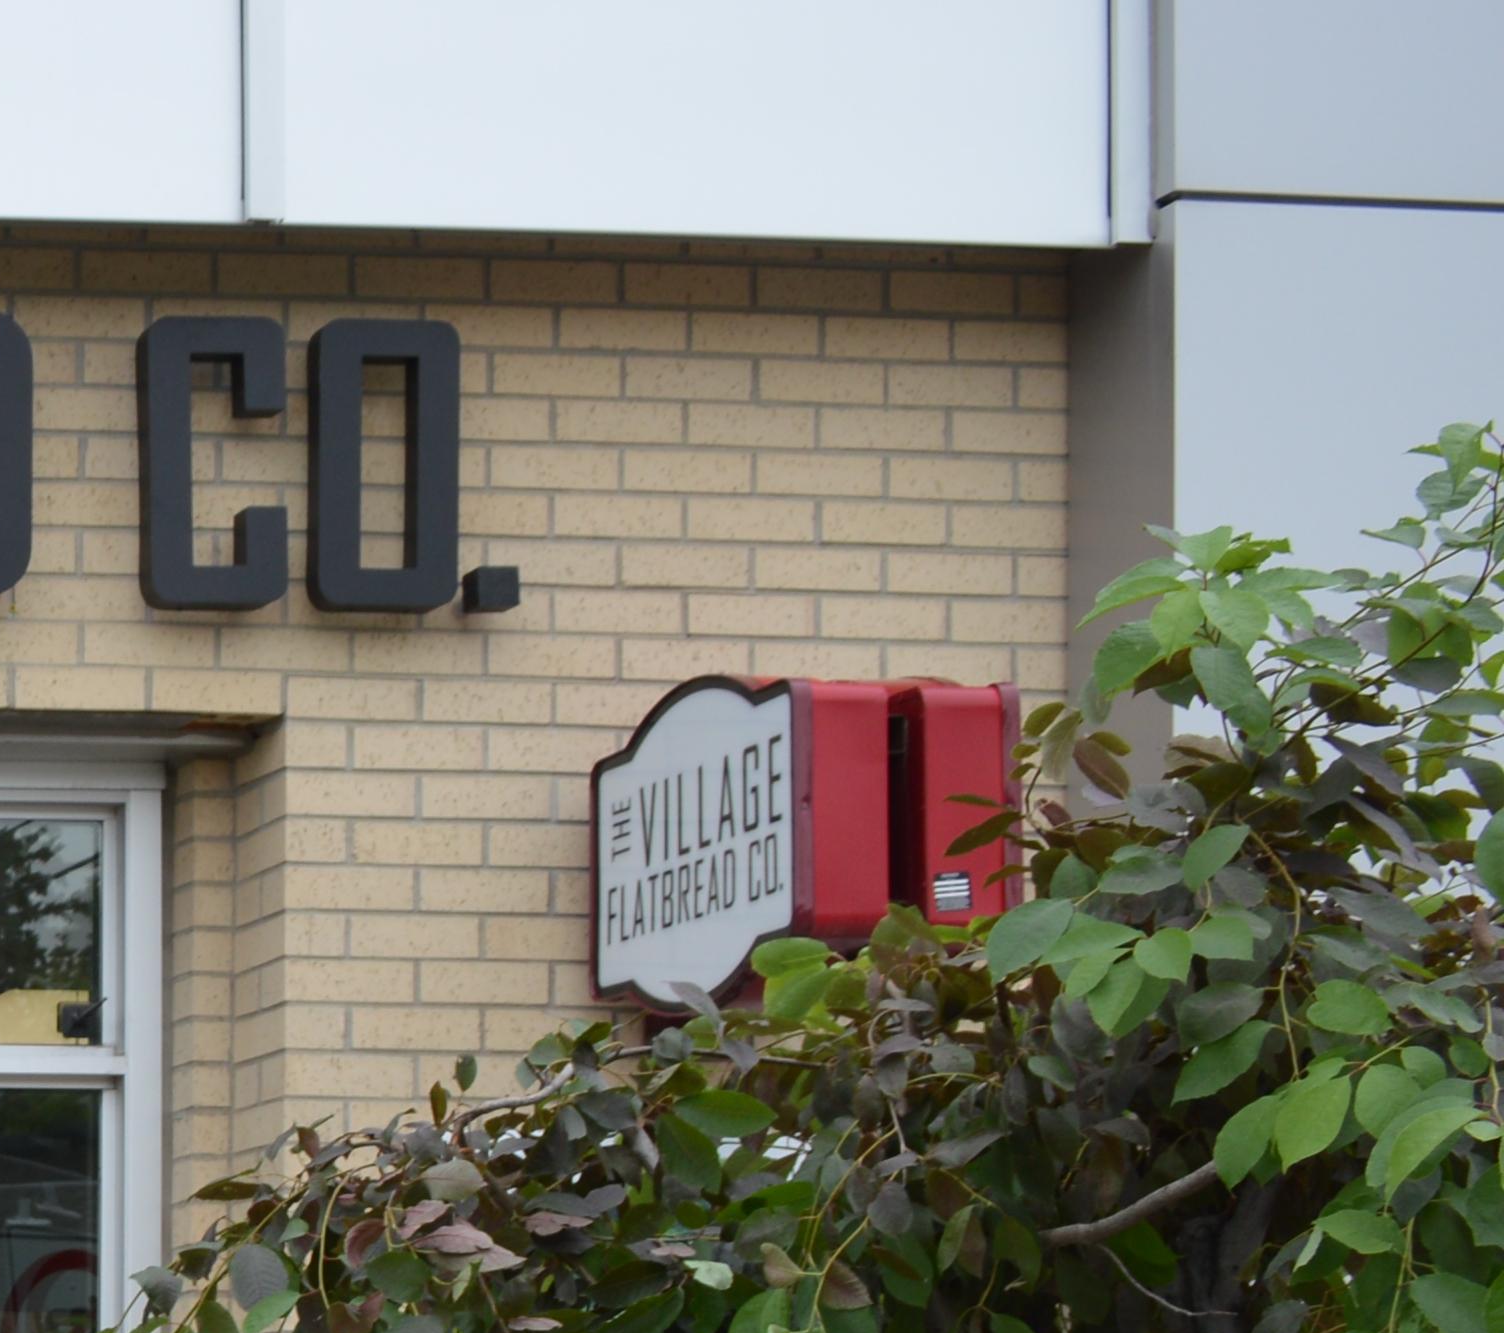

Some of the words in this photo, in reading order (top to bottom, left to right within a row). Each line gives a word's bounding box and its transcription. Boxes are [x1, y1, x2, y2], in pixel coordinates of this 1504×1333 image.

[136, 314, 521, 614] CO.
[611, 796, 632, 863] THE
[639, 734, 783, 868] VILLAGE
[606, 848, 736, 946] FLATBREAD
[748, 832, 784, 903] CO.
